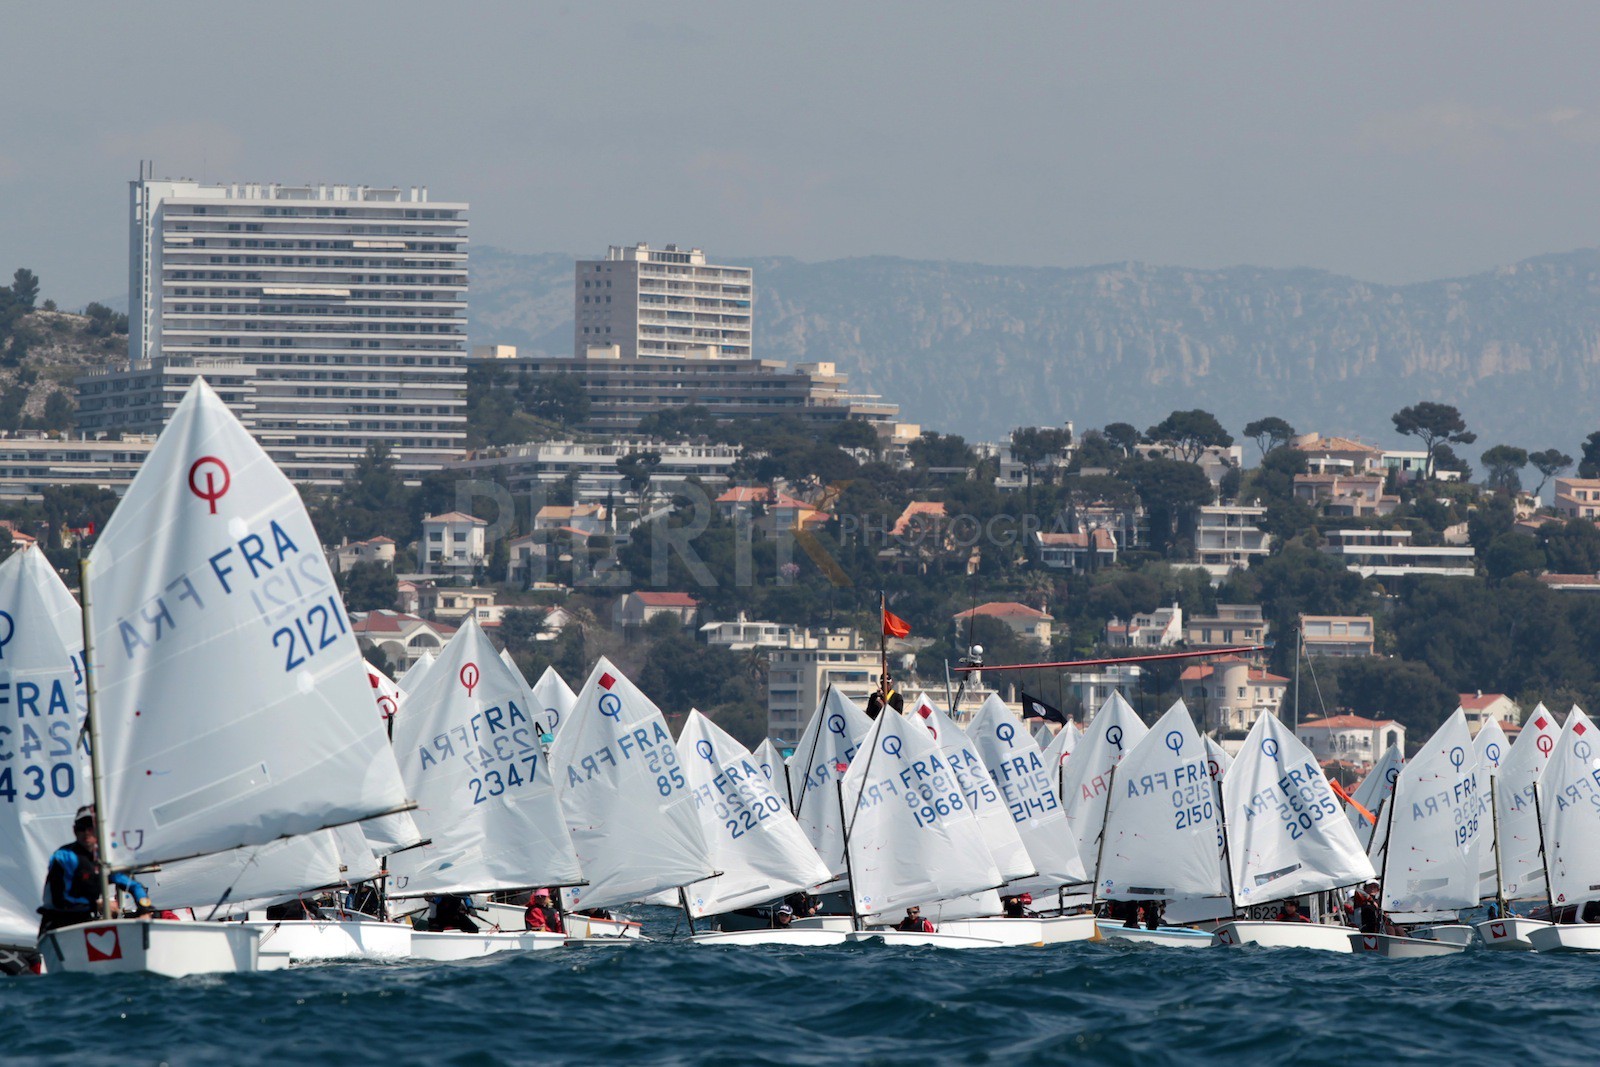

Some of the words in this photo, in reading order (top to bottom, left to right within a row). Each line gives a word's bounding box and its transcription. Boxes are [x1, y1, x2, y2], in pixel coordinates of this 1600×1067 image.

[208, 519, 299, 594] FRA
[272, 595, 347, 672] 2121
[470, 700, 527, 742] FRA
[617, 721, 668, 760] FRA
[712, 760, 758, 796] FRA
[899, 754, 945, 789] FRA
[947, 748, 978, 774] RA
[1000, 751, 1043, 782] FRA
[1174, 760, 1208, 787] FRA
[0, 762, 75, 803] 430
[468, 754, 538, 805] 2347
[656, 766, 686, 797] 85
[965, 783, 997, 811] 75
[1277, 762, 1320, 797] FRA
[1453, 773, 1478, 803] FRA
[725, 795, 781, 840] 2220
[913, 792, 964, 828] 1968
[1009, 790, 1058, 823] 2143
[1175, 801, 1213, 830] 2150
[1286, 796, 1336, 840] 2035
[1455, 814, 1479, 847] 1936
